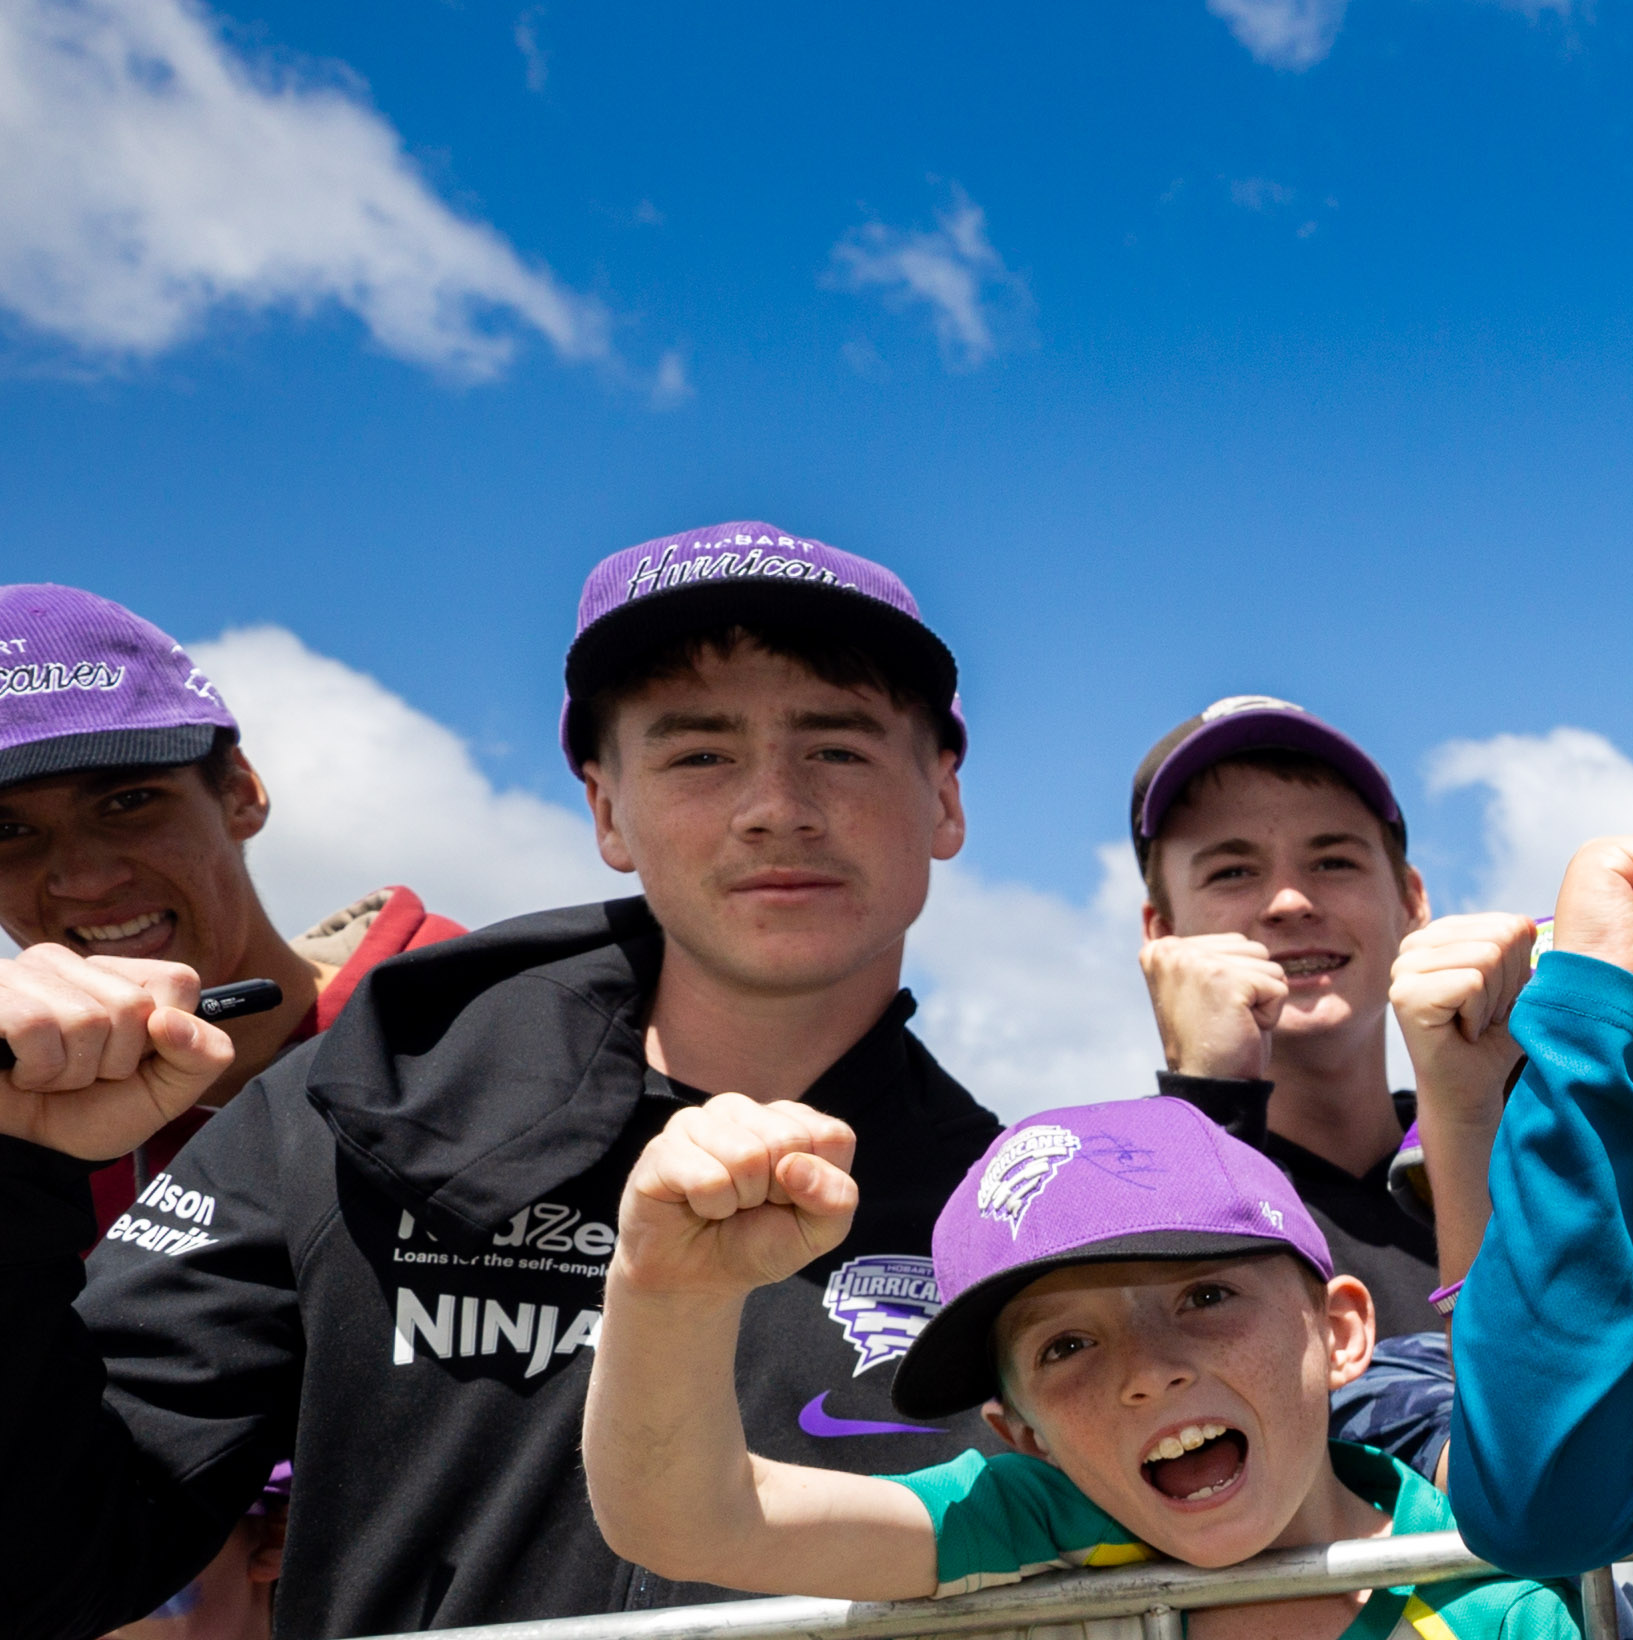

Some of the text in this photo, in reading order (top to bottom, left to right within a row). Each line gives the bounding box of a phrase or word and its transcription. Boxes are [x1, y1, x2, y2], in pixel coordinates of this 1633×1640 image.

[136, 1172, 216, 1227] ilson
[394, 1248, 449, 1264] Loans
[484, 1253, 515, 1267] the
[887, 1264, 932, 1276] HOBART
[393, 1286, 604, 1379] NINJA
